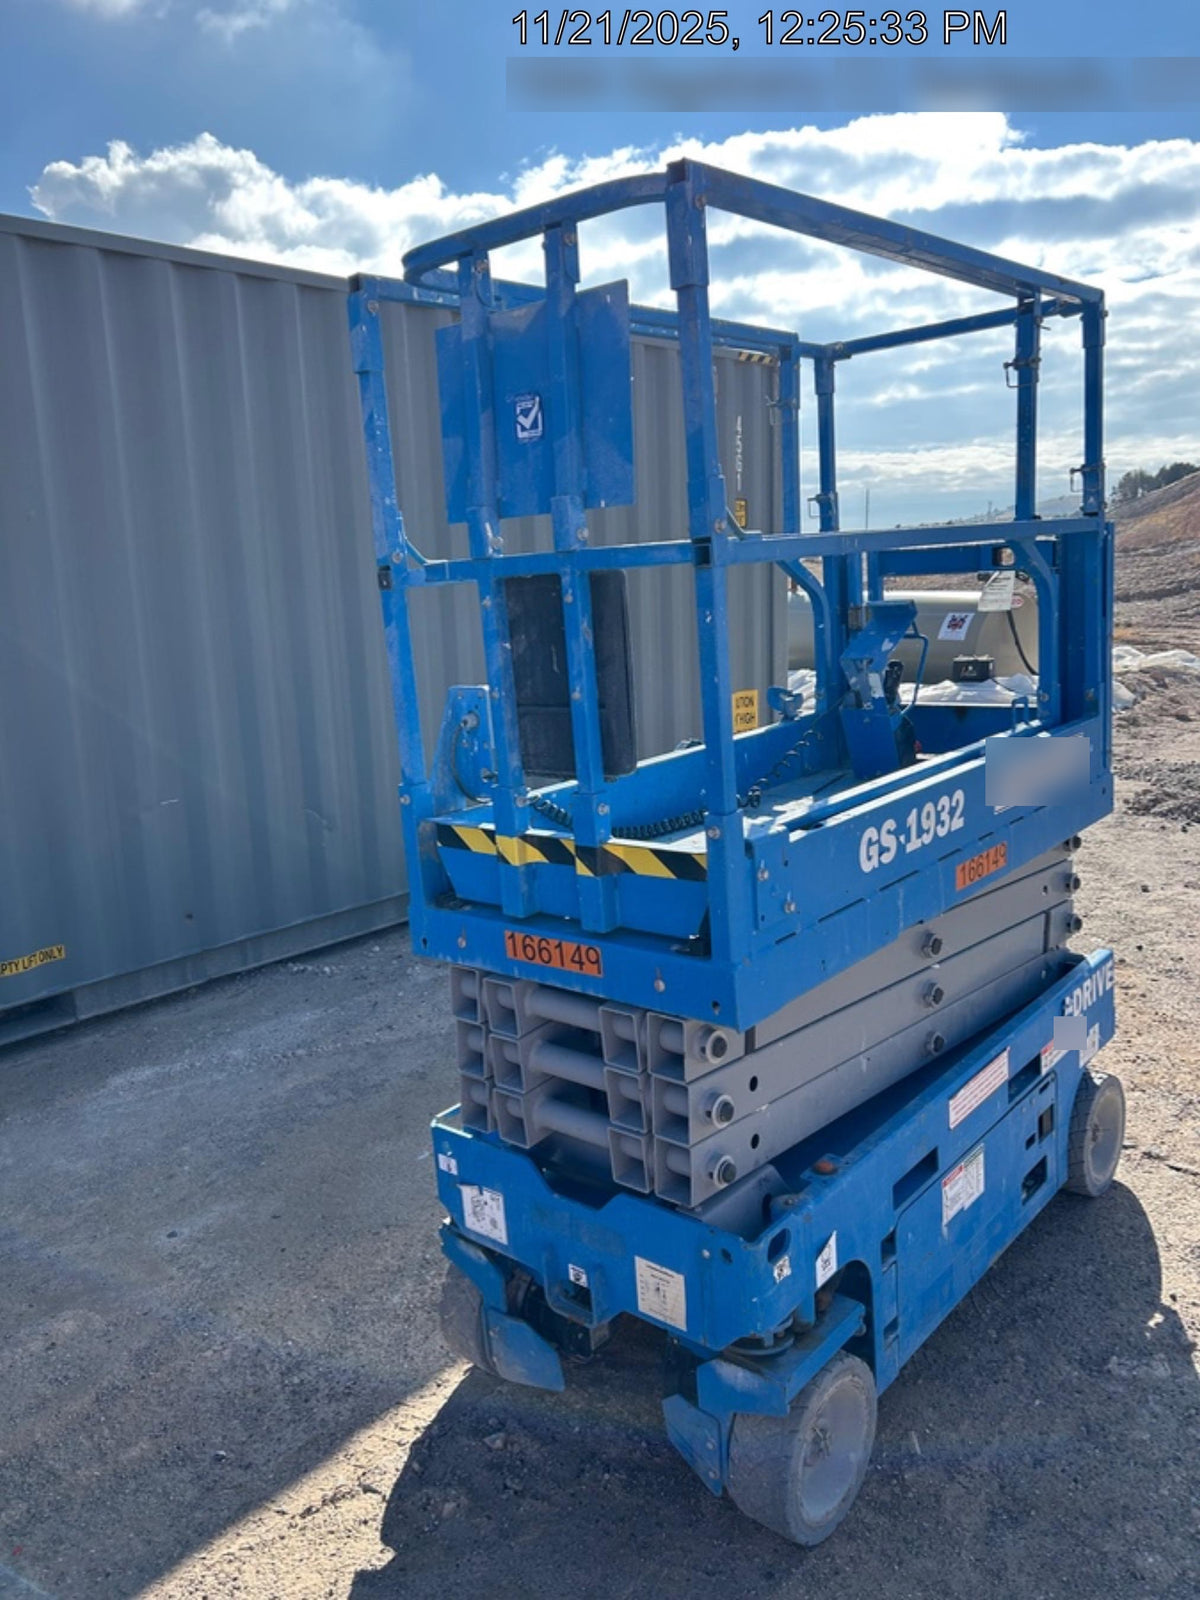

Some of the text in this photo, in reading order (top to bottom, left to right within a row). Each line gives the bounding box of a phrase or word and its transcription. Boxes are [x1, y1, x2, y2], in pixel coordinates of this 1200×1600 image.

[859, 789, 965, 873] GS-1932
[960, 843, 1007, 887] 166149
[22, 953, 38, 970] LIFT
[38, 945, 63, 963] ONLY
[507, 931, 602, 975] 166149
